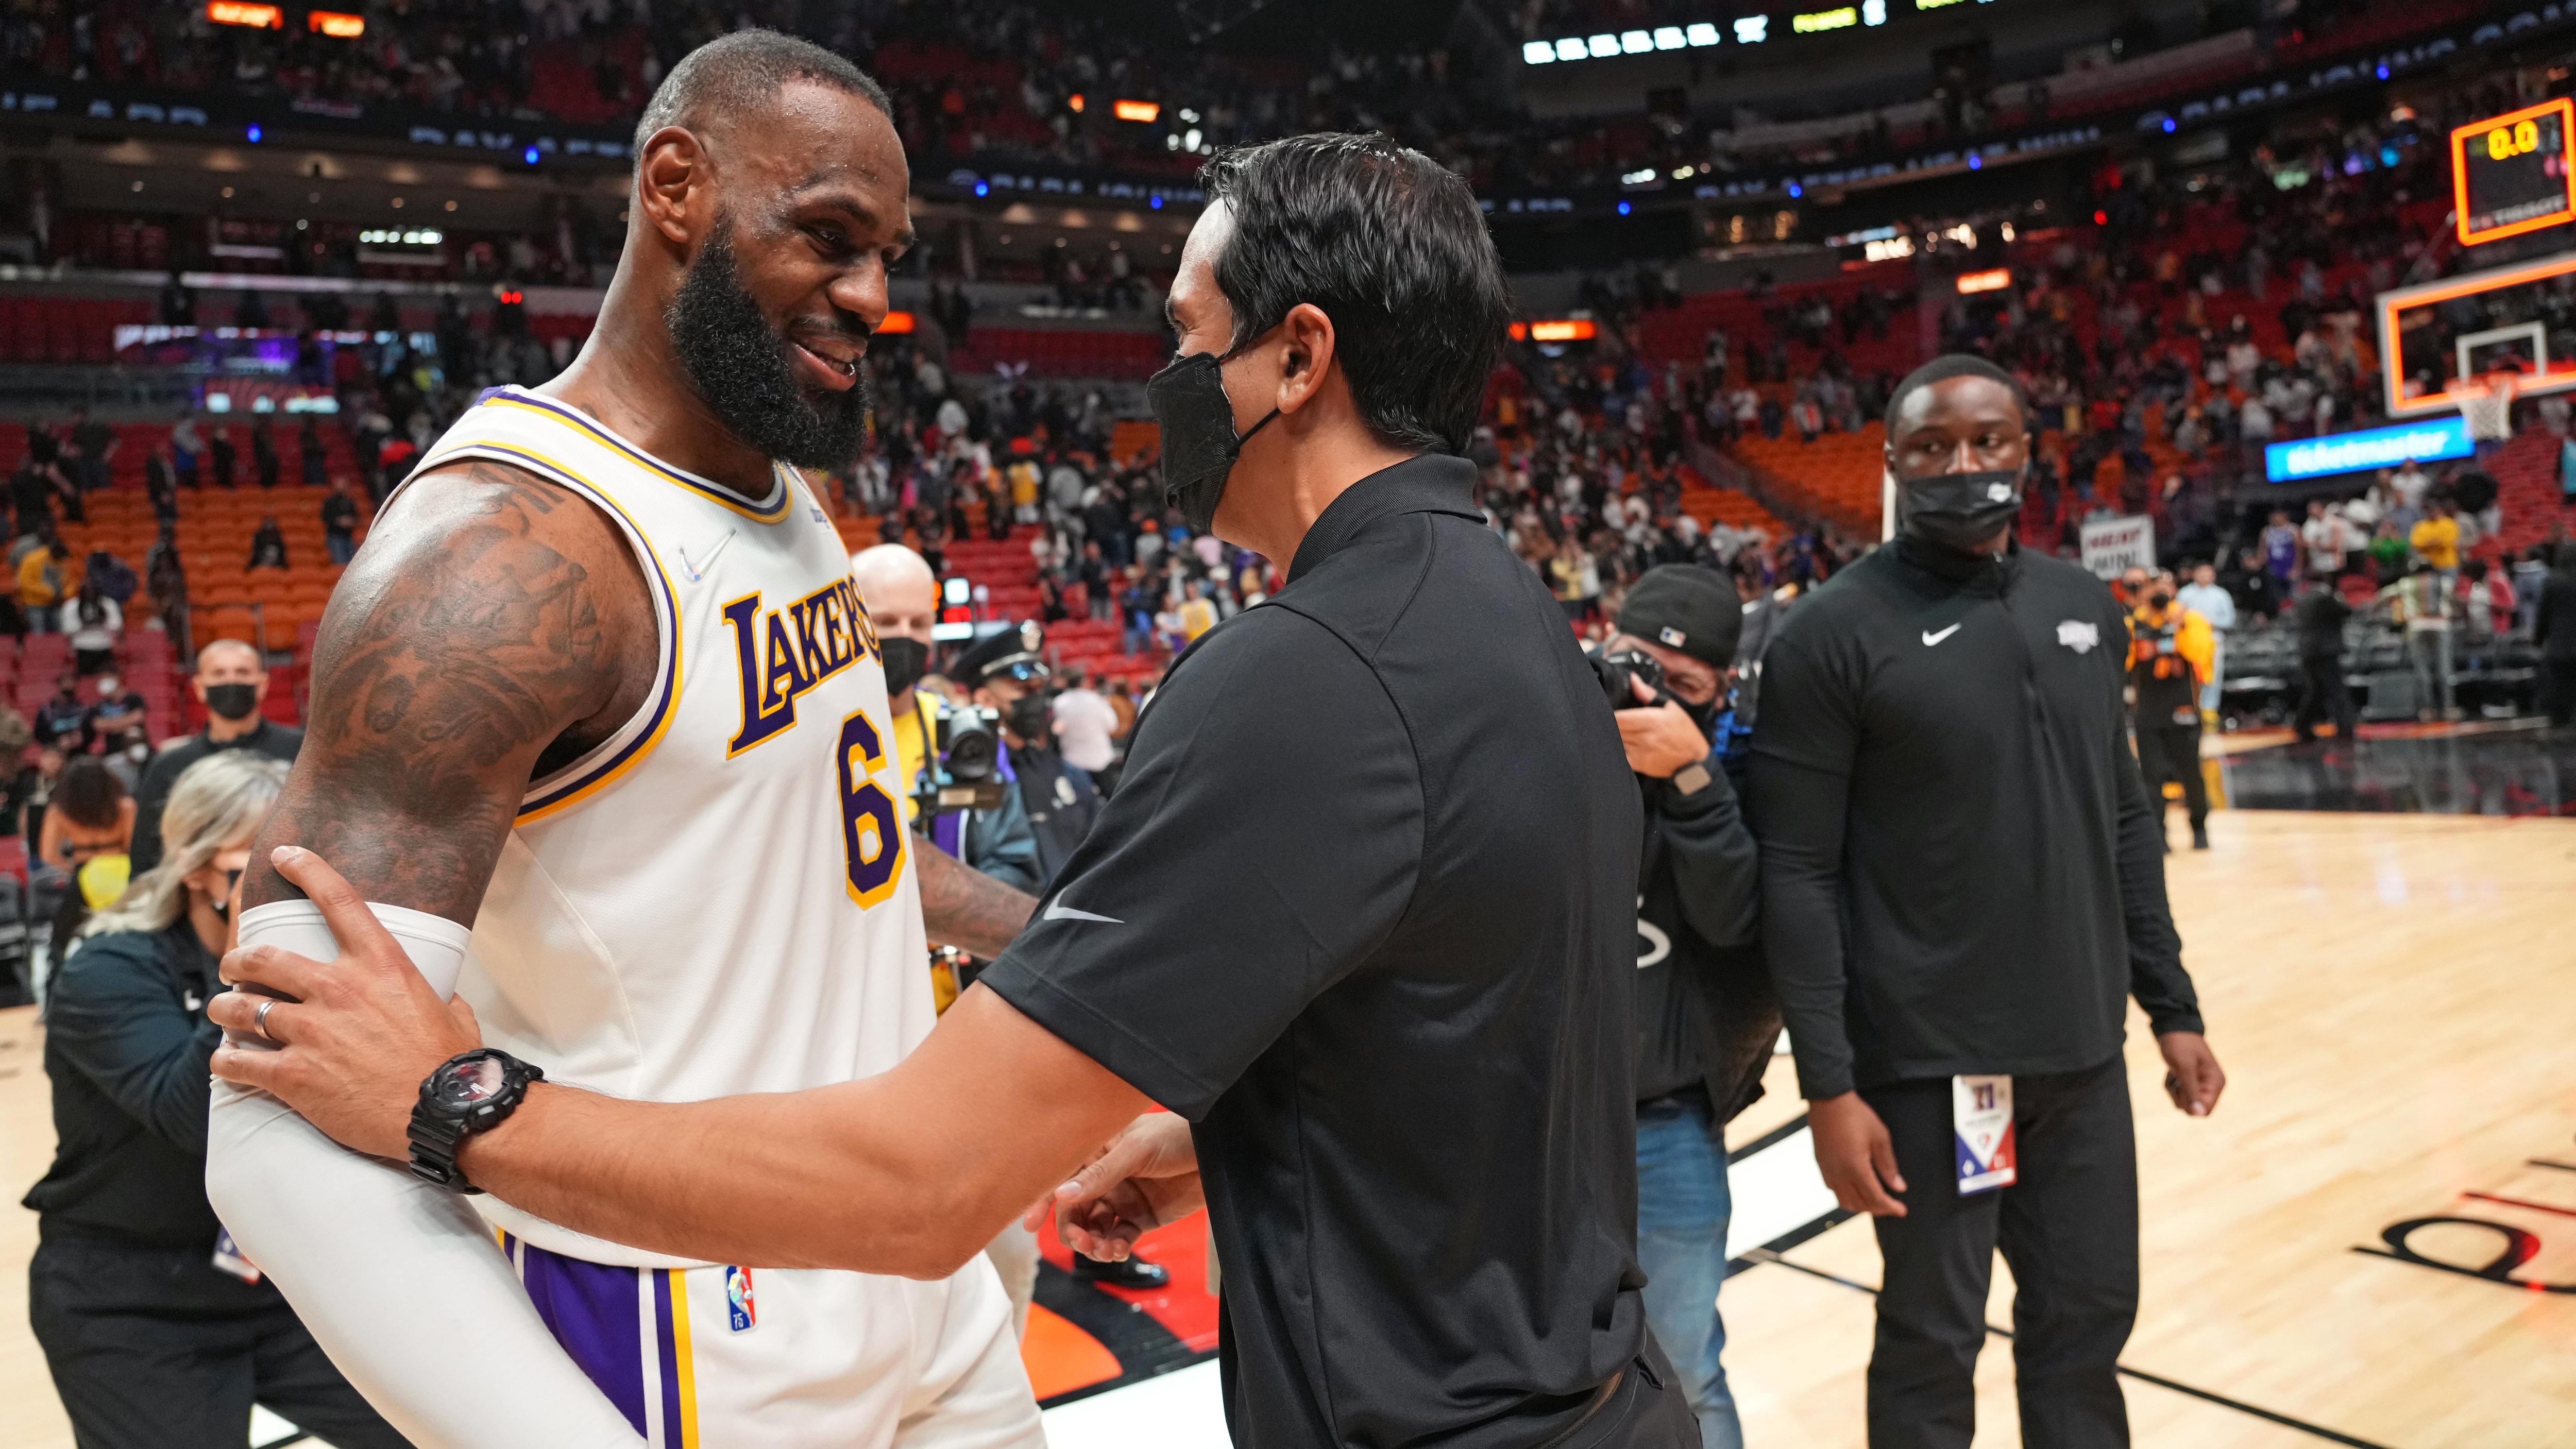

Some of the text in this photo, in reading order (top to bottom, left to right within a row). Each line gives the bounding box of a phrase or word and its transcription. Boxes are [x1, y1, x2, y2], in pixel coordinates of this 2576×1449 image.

[2488, 119, 2539, 161] 0.0
[721, 573, 883, 760] LAKERS
[836, 708, 906, 910] 6
